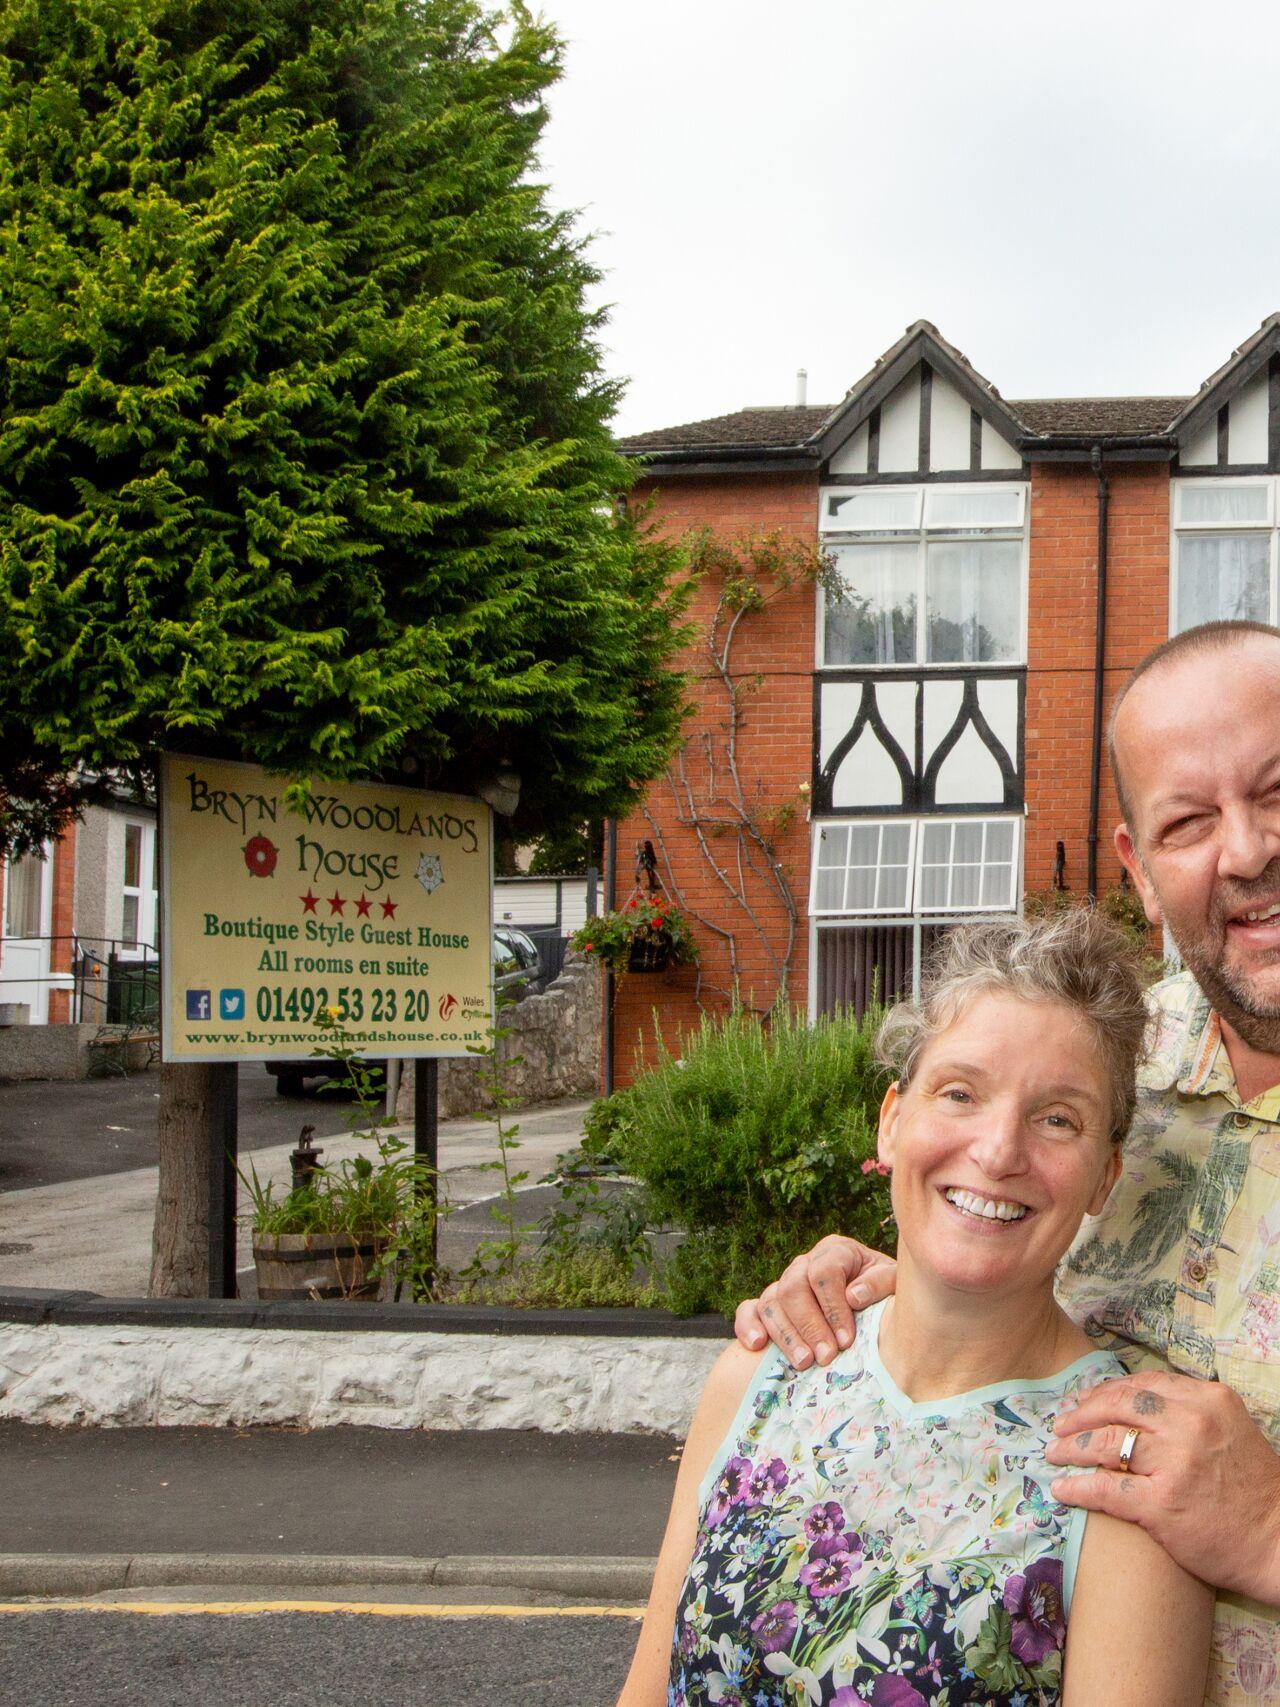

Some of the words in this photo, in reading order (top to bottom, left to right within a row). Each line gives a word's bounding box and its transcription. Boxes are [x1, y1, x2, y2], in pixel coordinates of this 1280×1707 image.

[185, 772, 278, 836] BRYN
[303, 793, 479, 854] WOODLANDS
[203, 913, 299, 945] Boutique
[305, 920, 355, 948] Style
[360, 923, 412, 947] Guest
[417, 927, 470, 949] House
[257, 950, 288, 972] All
[294, 955, 354, 974] rooms
[359, 959, 381, 975] en
[386, 957, 429, 977] suite
[256, 986, 330, 1023] 01492
[337, 986, 364, 1022] 53
[371, 988, 398, 1022] 23
[404, 988, 429, 1022] 20
[462, 996, 485, 1007] Wales
